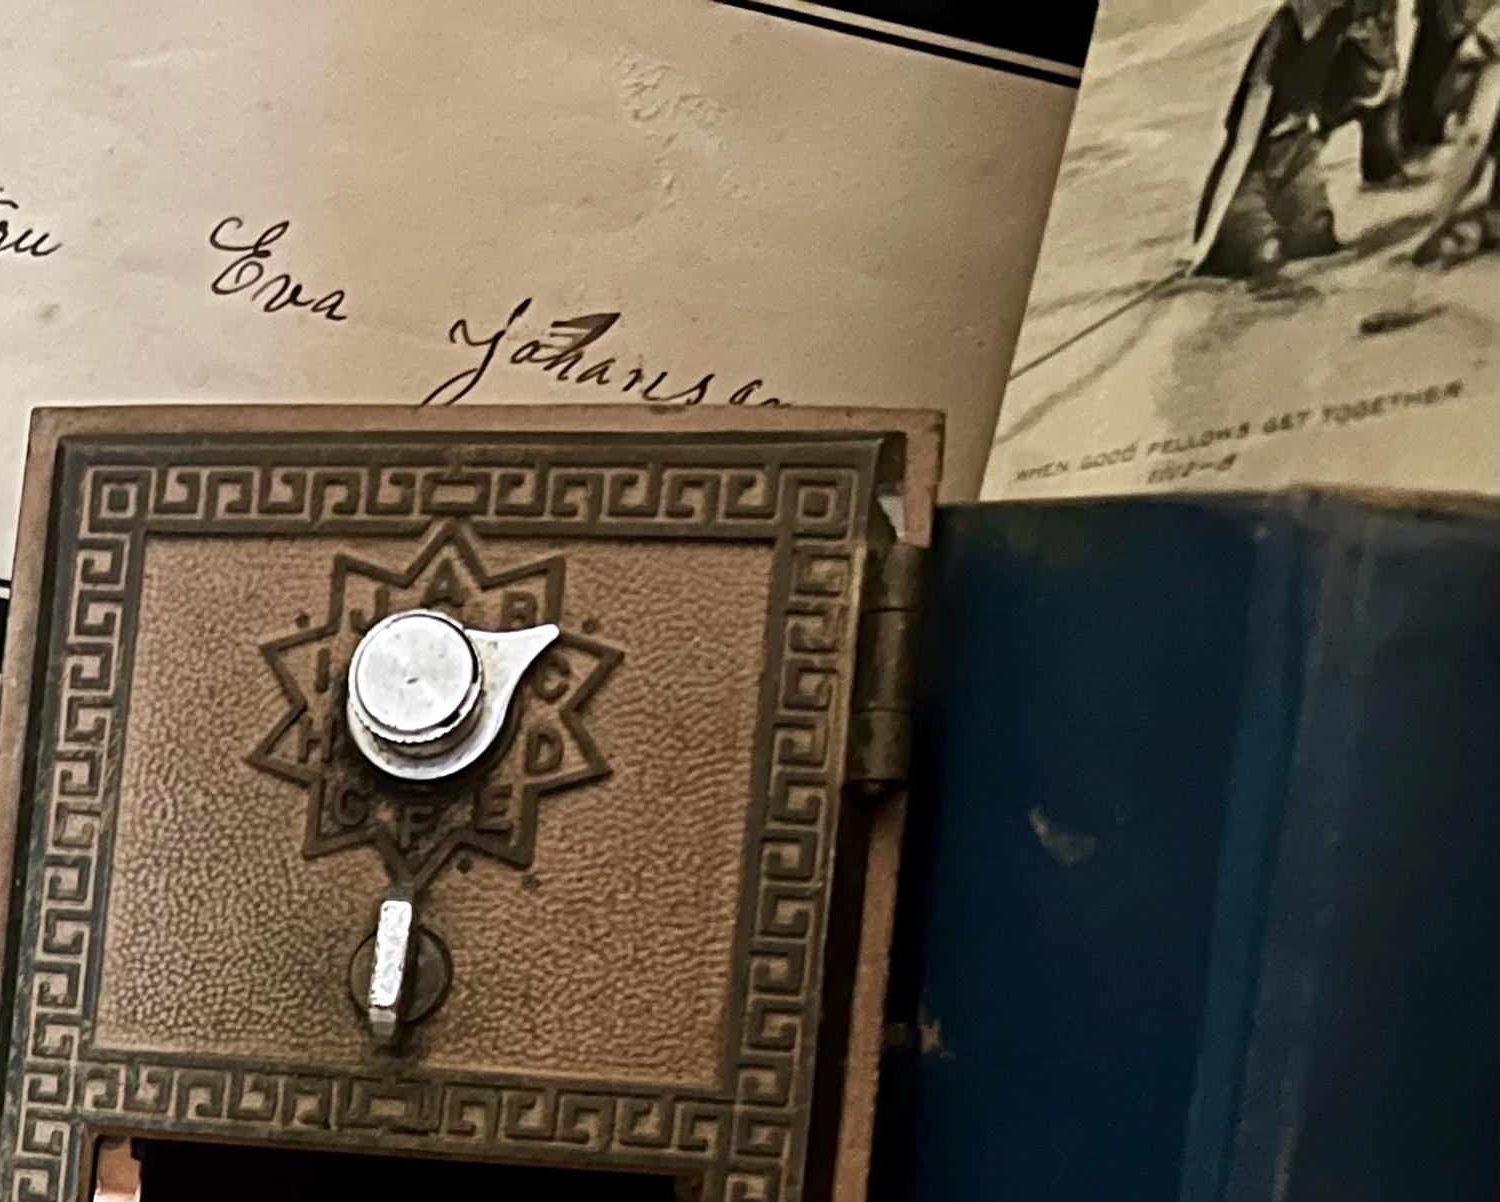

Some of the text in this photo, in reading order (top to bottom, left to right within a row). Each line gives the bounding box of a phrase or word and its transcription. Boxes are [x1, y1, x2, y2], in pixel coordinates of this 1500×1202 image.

[208, 216, 348, 321] Eva
[420, 557, 467, 608] A
[532, 657, 573, 706] C
[524, 726, 565, 776] D
[333, 786, 369, 828] G
[474, 785, 514, 836] E
